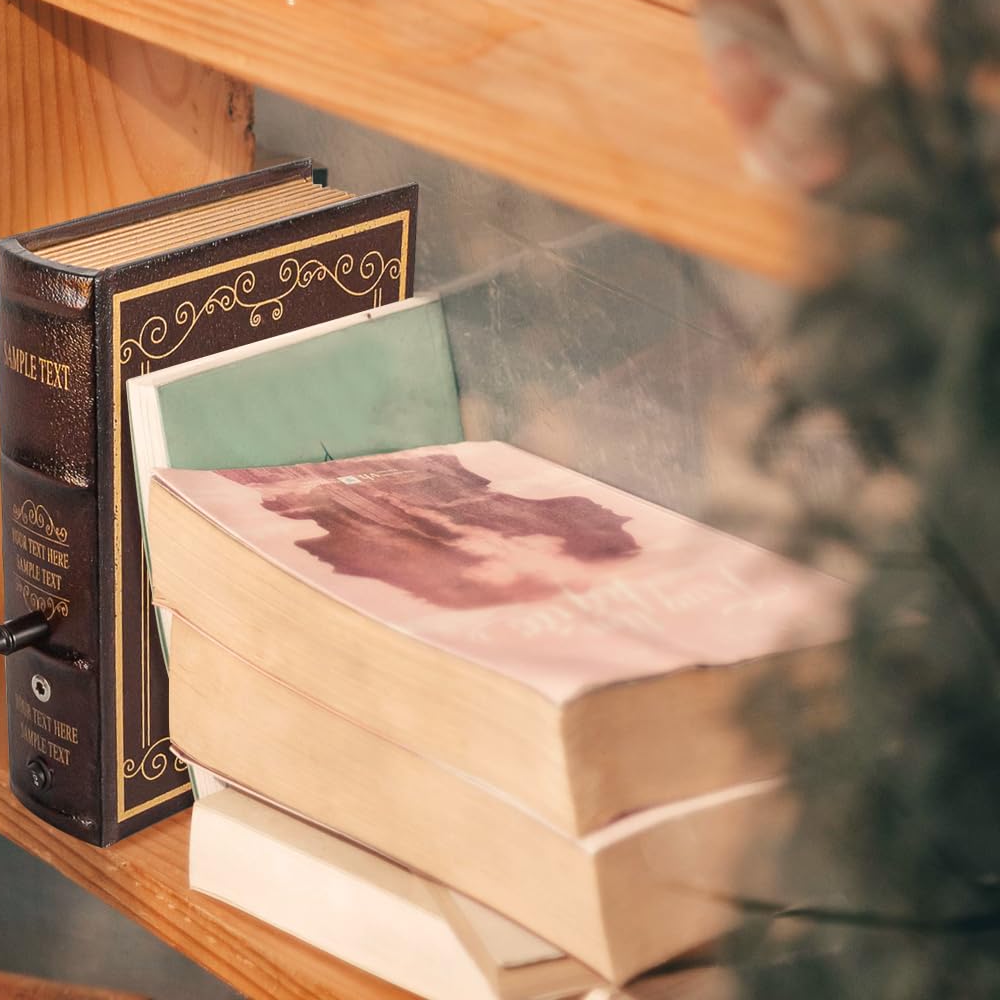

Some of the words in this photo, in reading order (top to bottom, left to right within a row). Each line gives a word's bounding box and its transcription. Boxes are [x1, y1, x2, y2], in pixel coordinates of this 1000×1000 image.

[39, 356, 70, 391] TEXT
[28, 538, 46, 560] TEXT
[47, 547, 71, 570] HERE
[41, 568, 62, 591] TEXT
[32, 706, 52, 733] TEXT
[53, 719, 79, 745] HERE
[47, 741, 70, 767] TEXT
